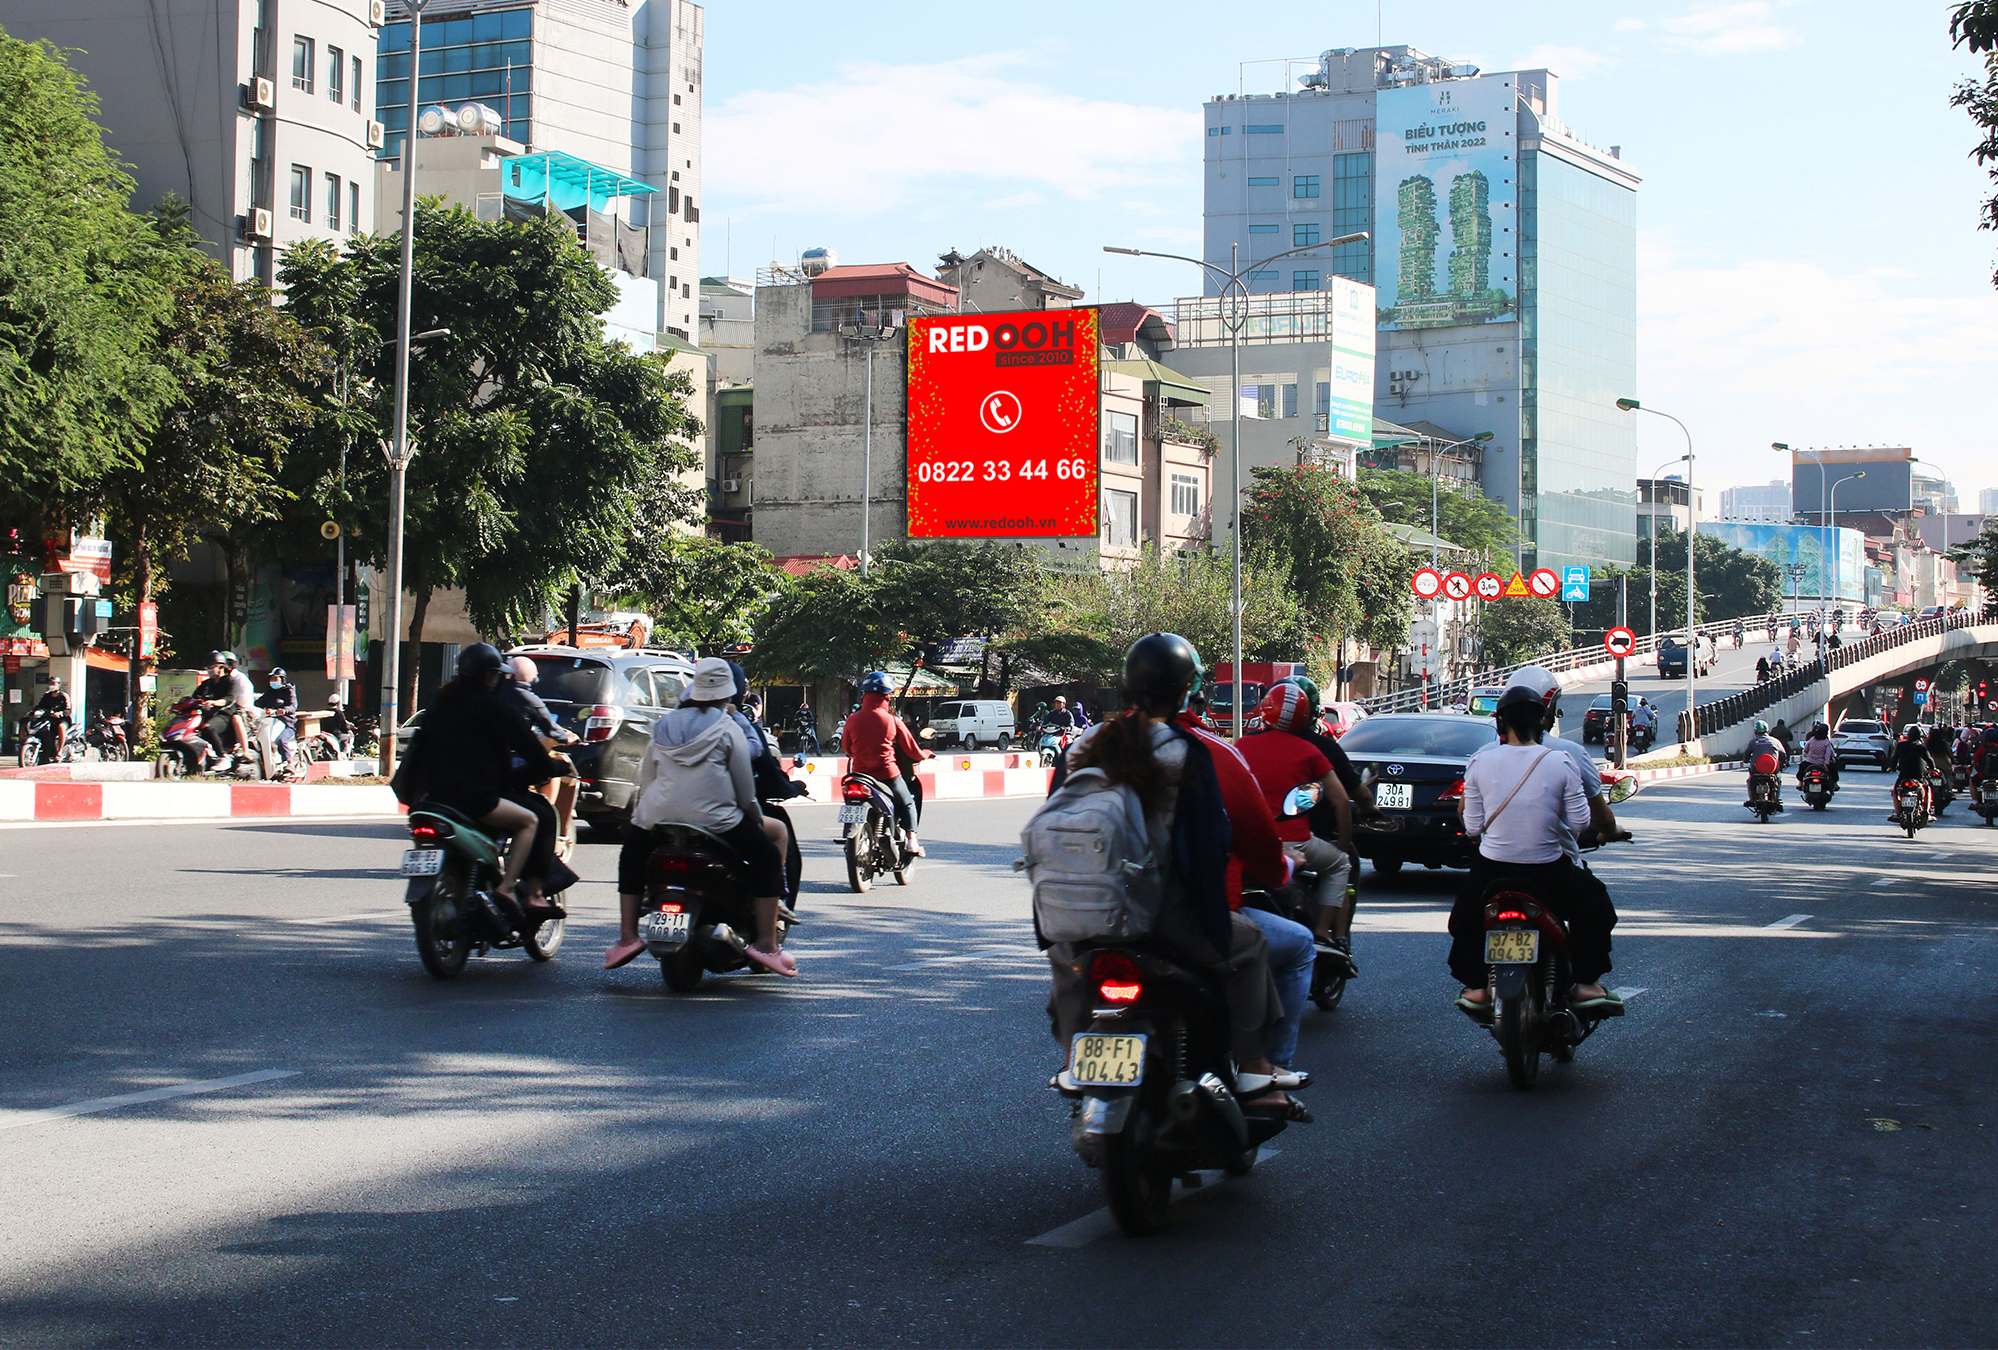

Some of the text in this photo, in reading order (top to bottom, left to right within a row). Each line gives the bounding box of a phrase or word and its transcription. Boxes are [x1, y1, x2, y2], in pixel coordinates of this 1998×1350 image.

[1430, 106, 1460, 115] MERAKI
[1405, 120, 1486, 140] BIỂU TƯỢNG
[1405, 143, 1428, 154] TÌNH
[1461, 137, 1486, 148] 2022
[929, 321, 1074, 354] RED OOH
[1000, 351, 1069, 366] since 2010
[918, 458, 1086, 482] 0822 33 44 66
[945, 516, 1056, 530] www.redooh.vn
[1385, 784, 1404, 796] 30A
[1377, 795, 1409, 808] 249.81
[654, 912, 685, 926] 29-T1
[1493, 932, 1531, 947] 37-B2
[1488, 947, 1534, 962] 094.33
[1084, 1037, 1133, 1059] 88-F1
[1076, 1060, 1139, 1082] 104.43
